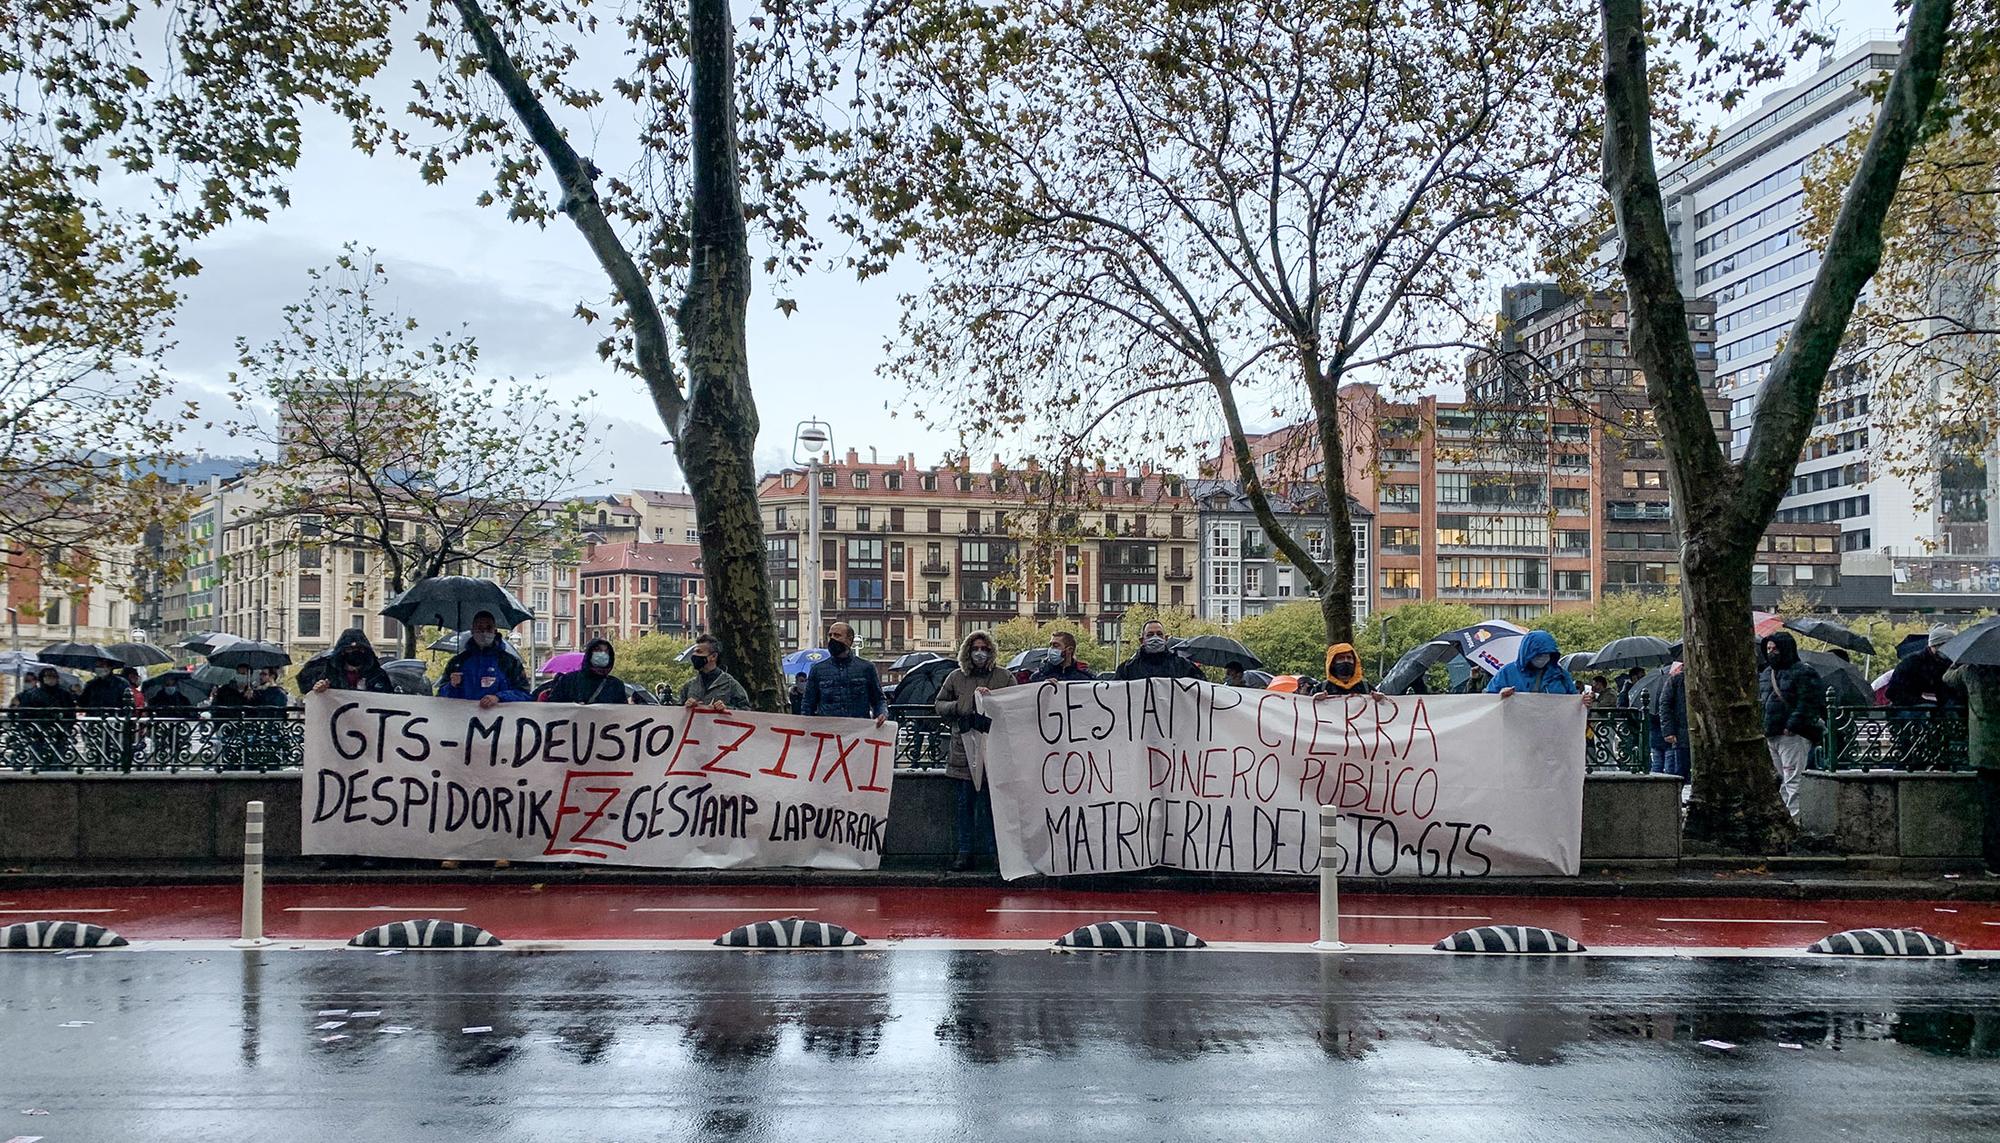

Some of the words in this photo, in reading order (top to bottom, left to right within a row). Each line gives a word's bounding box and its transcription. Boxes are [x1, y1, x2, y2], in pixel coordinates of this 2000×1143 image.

[664, 707, 756, 778] EZ
[758, 726, 893, 793] ITXI
[1257, 693, 1438, 762] CIERRA
[1042, 749, 1113, 795] CON
[768, 801, 889, 856] LAPURRAK
[1045, 798, 1235, 874] MATRICERIA
